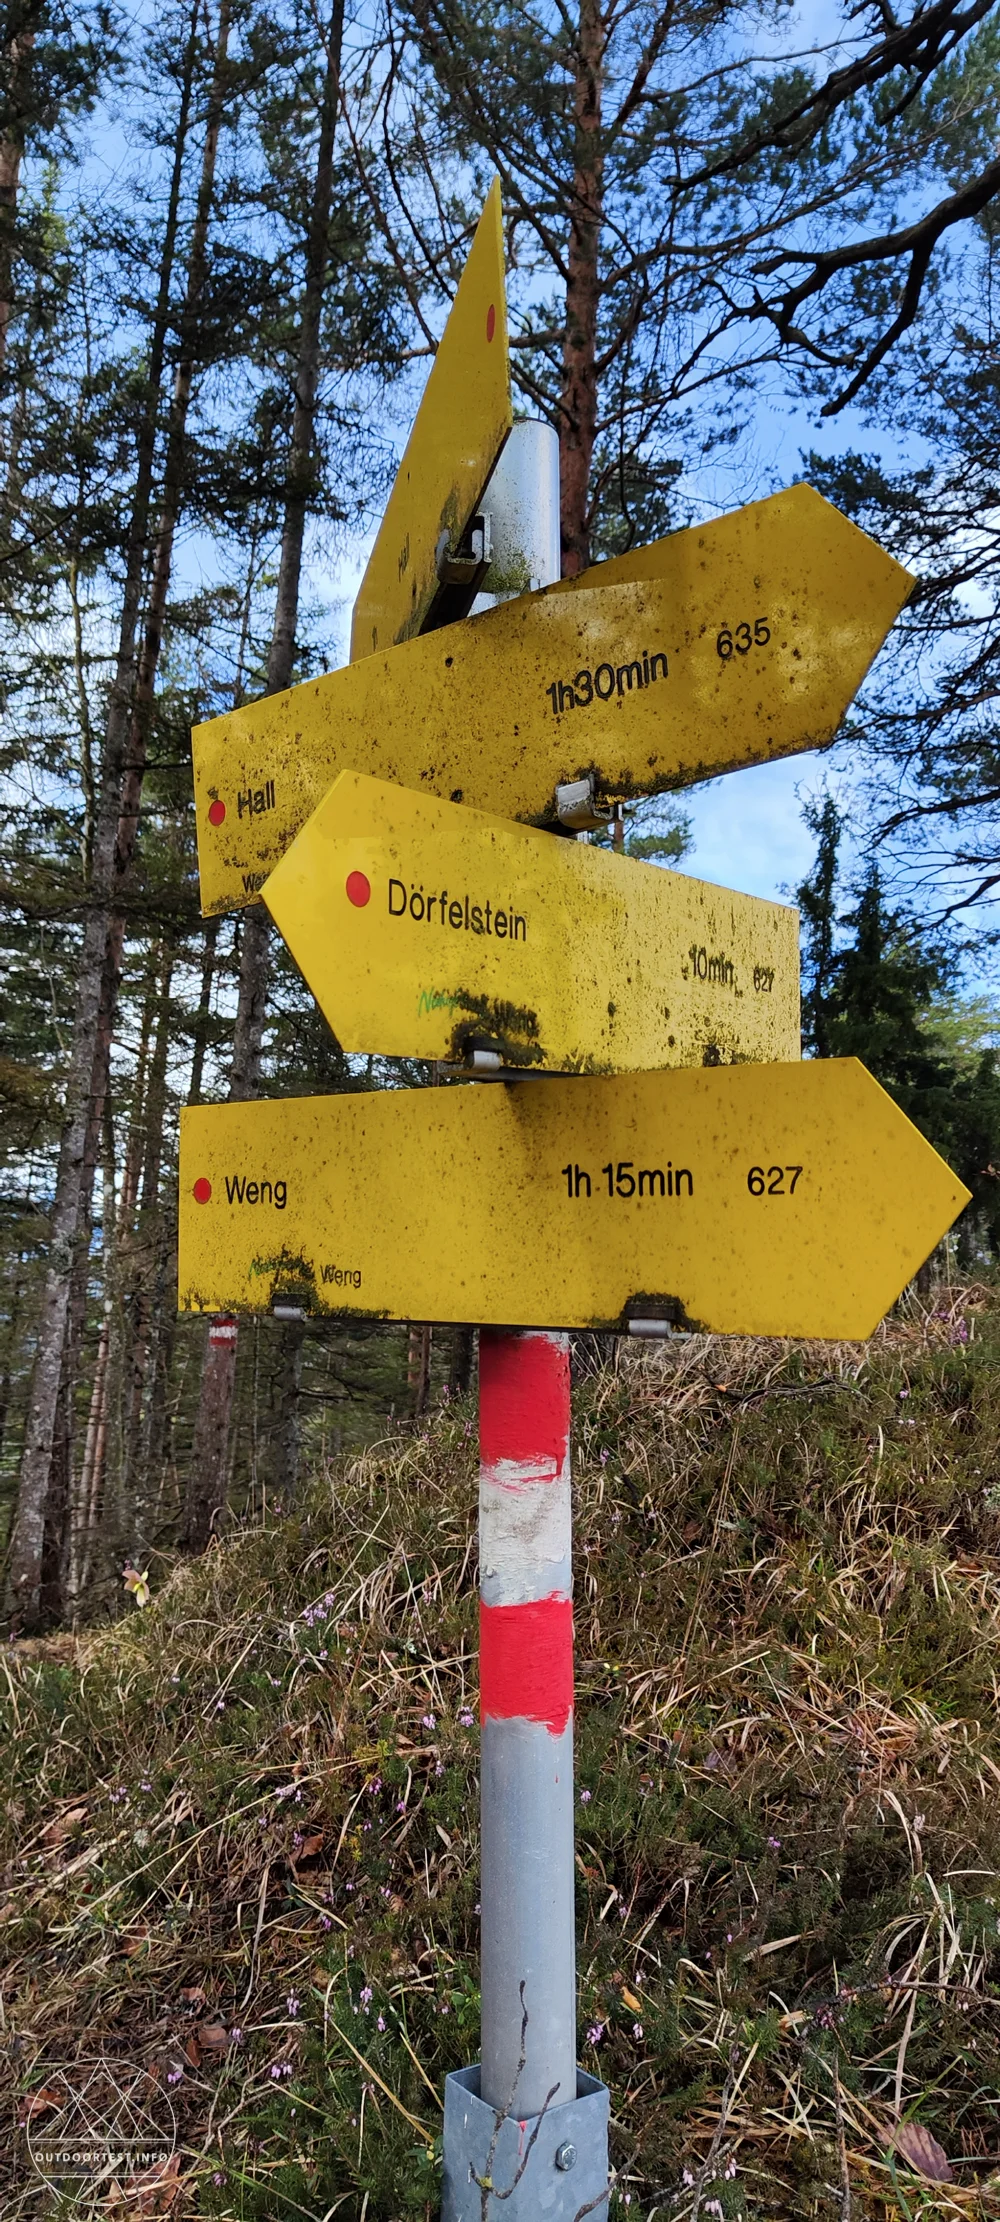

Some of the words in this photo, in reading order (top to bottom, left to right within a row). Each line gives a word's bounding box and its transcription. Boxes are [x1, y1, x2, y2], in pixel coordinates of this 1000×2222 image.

[237, 779, 276, 819] Hall
[546, 650, 669, 715] 1h30min
[716, 616, 771, 660] 635
[388, 878, 527, 942] Dörfelstein
[224, 1175, 288, 1209] Weng
[561, 1163, 592, 1198] 1h
[601, 1161, 694, 1198] 15min
[747, 1166, 803, 1197] 627
[319, 1263, 362, 1289] Weng
